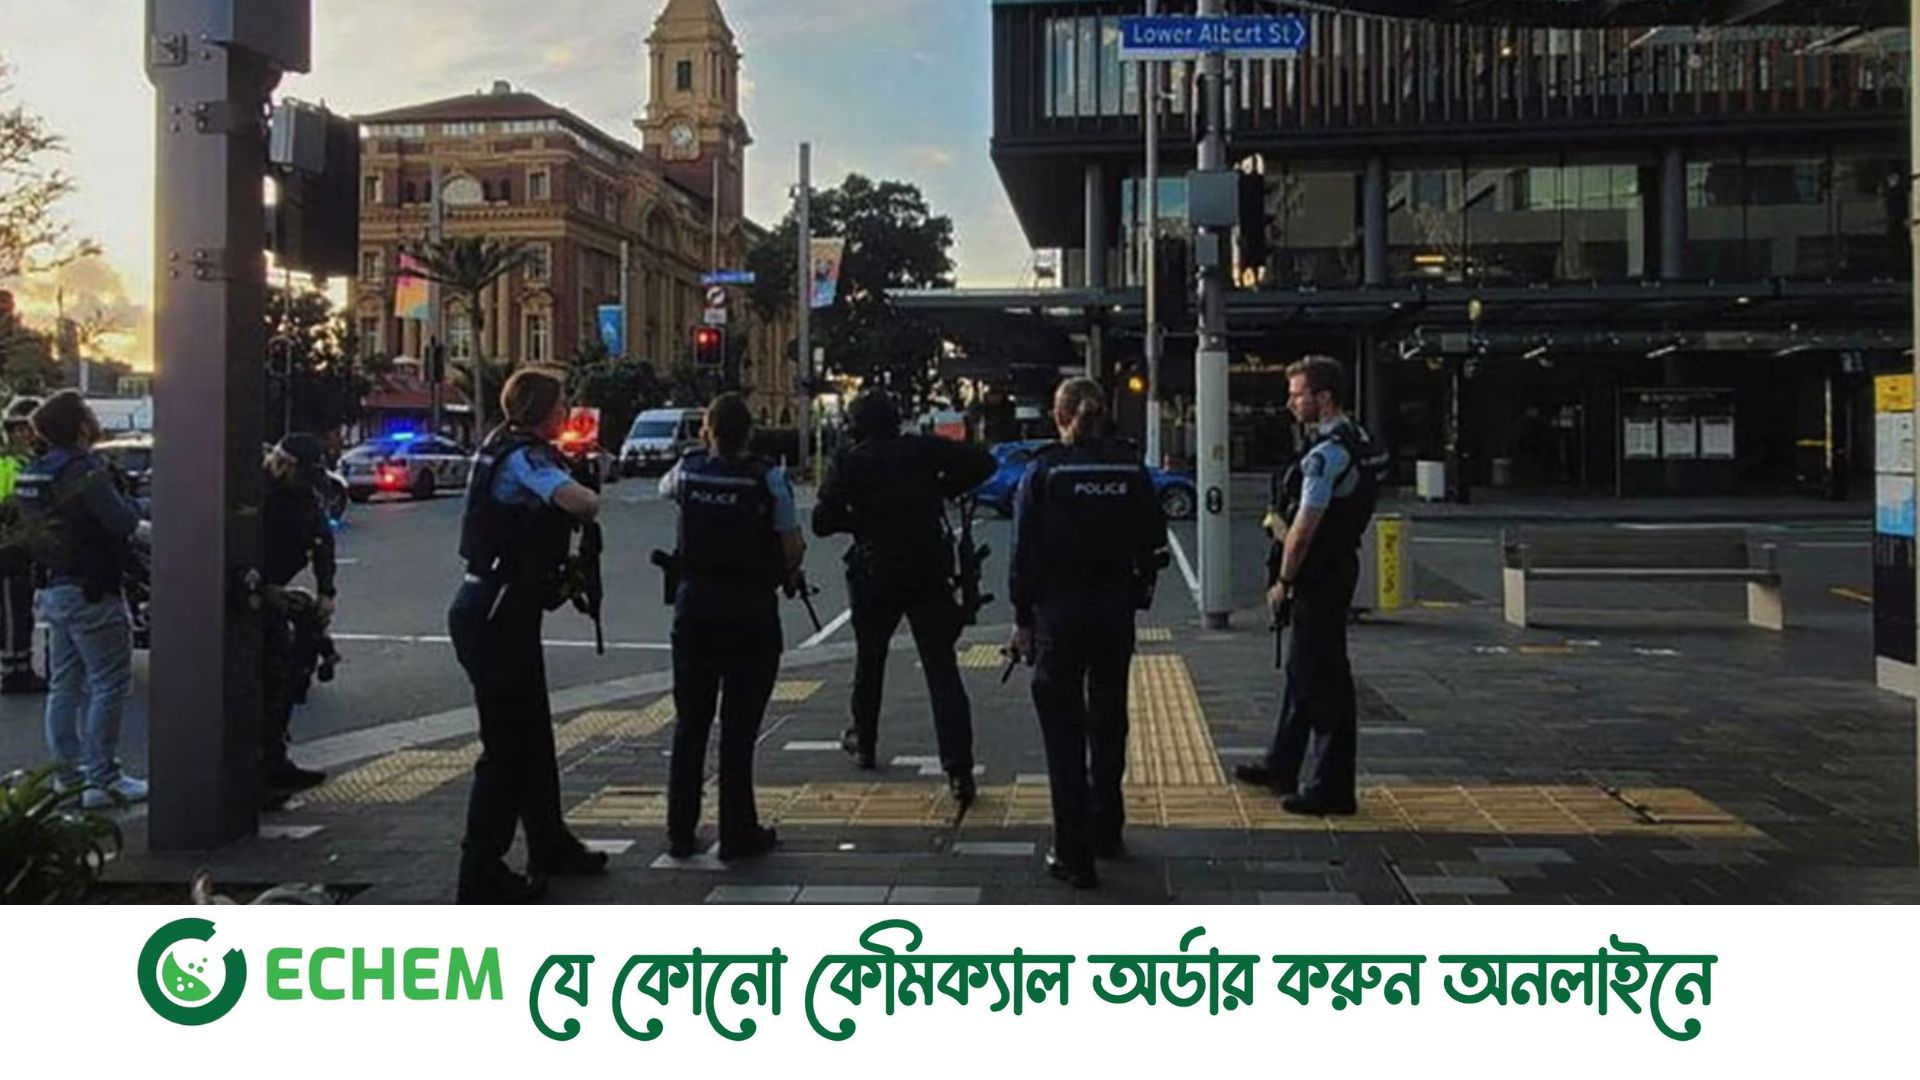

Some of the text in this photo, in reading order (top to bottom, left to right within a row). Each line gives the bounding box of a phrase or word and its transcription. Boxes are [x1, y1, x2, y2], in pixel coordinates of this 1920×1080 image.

[1133, 22, 1290, 44] Lower Albert St
[1074, 481, 1128, 495] POLICE
